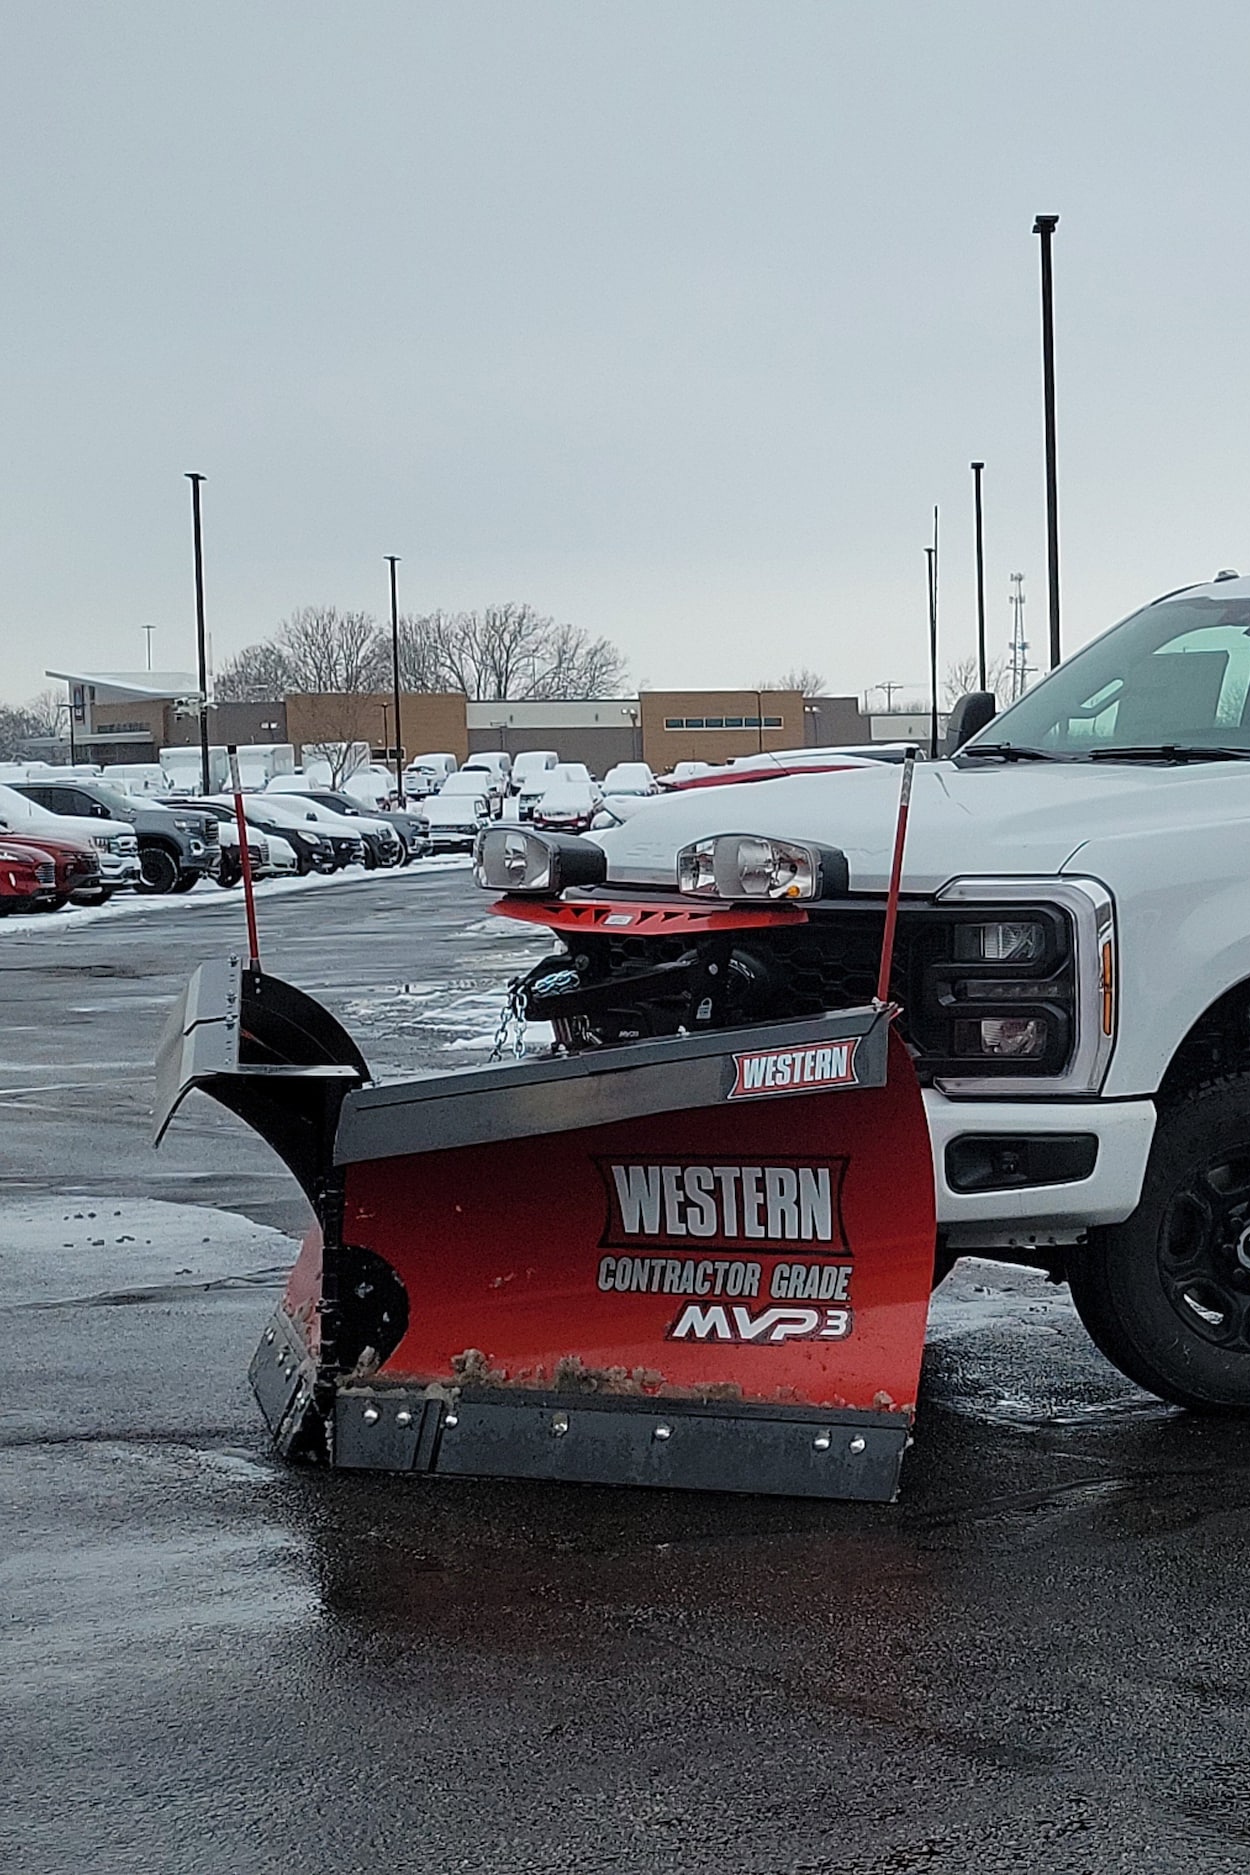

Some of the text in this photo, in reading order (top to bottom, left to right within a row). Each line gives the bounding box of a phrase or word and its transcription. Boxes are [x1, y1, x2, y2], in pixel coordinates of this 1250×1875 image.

[743, 1046, 848, 1088] WESTERN
[611, 1165, 832, 1240] WESTERN
[598, 1257, 853, 1300] CONTRACTOR GRADE
